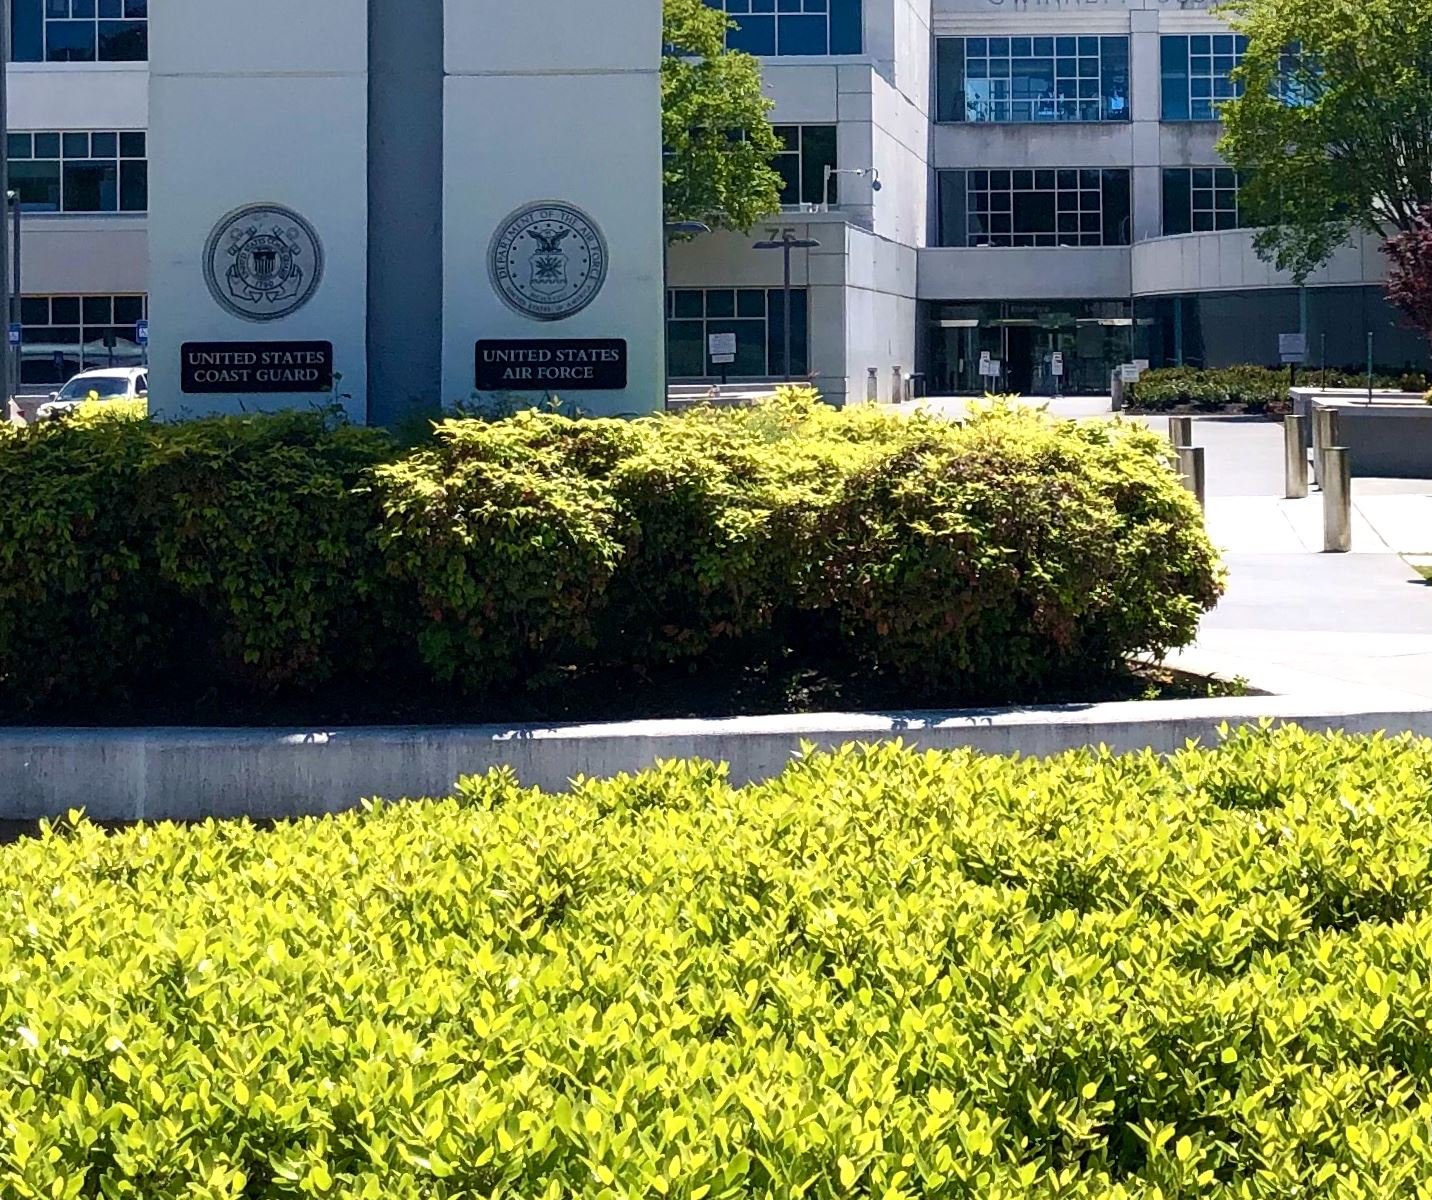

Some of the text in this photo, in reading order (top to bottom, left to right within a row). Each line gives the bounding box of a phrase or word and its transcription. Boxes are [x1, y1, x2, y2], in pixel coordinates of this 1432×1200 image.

[540, 211, 555, 219] OF
[560, 212, 577, 226] THE
[580, 226, 596, 242] AIR
[189, 352, 325, 365] UNITED STATES
[483, 349, 620, 362] UNITED STATES
[194, 369, 318, 382] COAST GUARD
[503, 366, 594, 379] AIR FORCE
